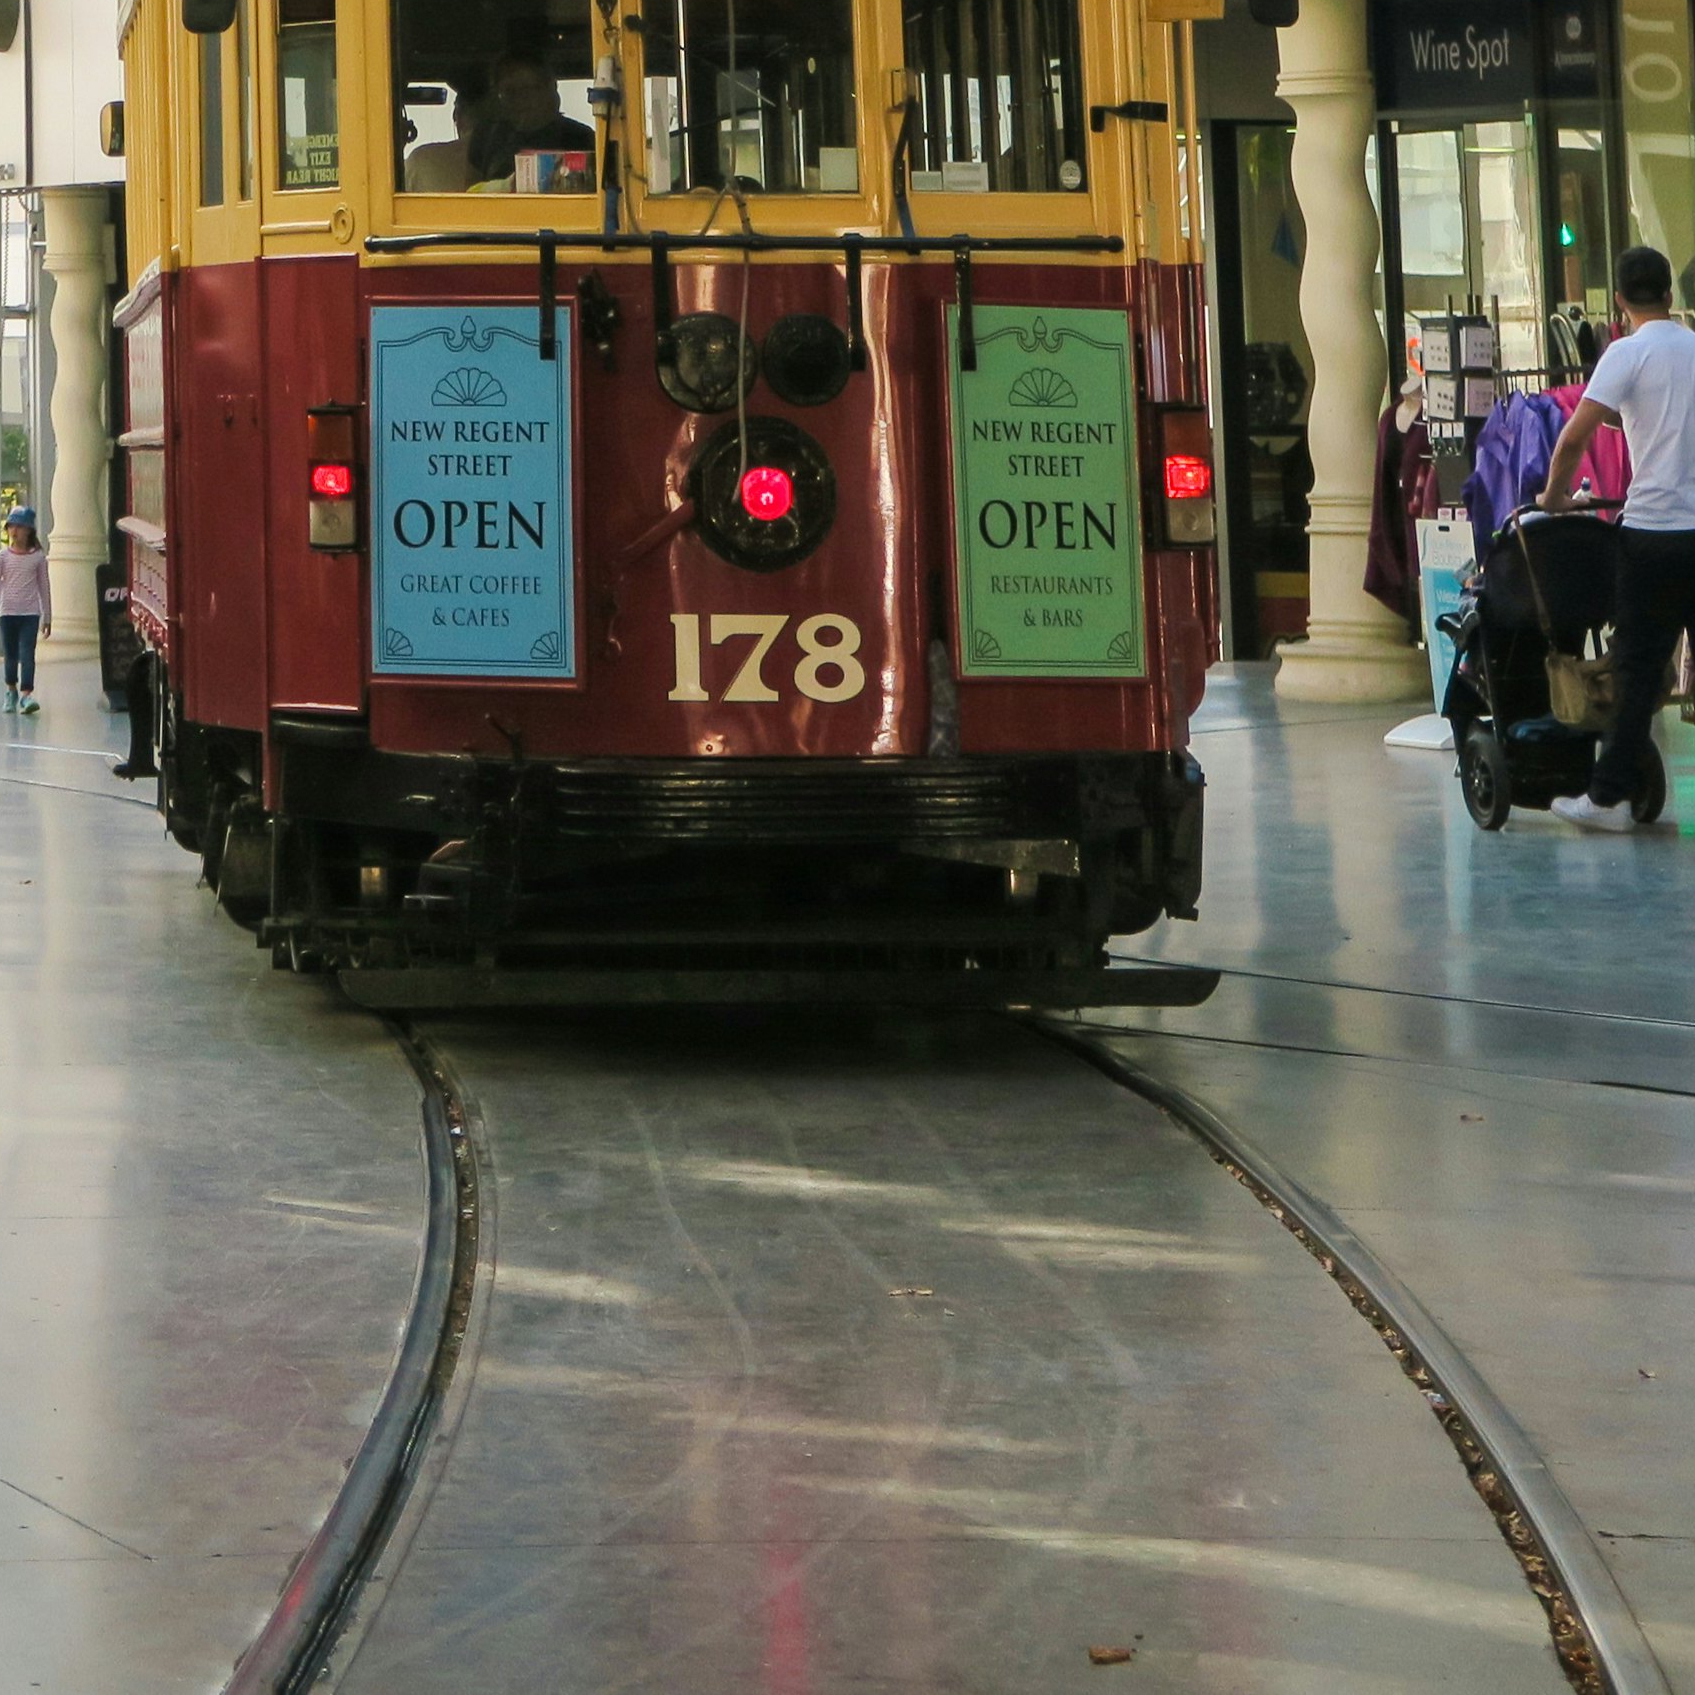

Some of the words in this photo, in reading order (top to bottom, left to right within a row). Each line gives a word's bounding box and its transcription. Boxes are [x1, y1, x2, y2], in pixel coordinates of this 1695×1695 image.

[1409, 29, 1461, 73] Wine
[1465, 23, 1510, 81] Spot
[391, 421, 446, 443] NEW
[453, 421, 550, 443] REGENT
[972, 420, 1023, 442] NEW
[1030, 422, 1117, 445] REGENT
[427, 454, 513, 477] STREET
[1008, 454, 1085, 478] STREET
[393, 499, 547, 550] OPEN
[978, 499, 1117, 551] OPEN
[400, 574, 464, 594] GREAT
[469, 575, 542, 595] COFFEE
[991, 574, 1114, 596] RESTAURANTS
[432, 607, 447, 627] &
[452, 607, 510, 627] CAFES
[1023, 608, 1036, 627] &
[1042, 609, 1084, 627] BARS
[667, 612, 866, 703] 178
